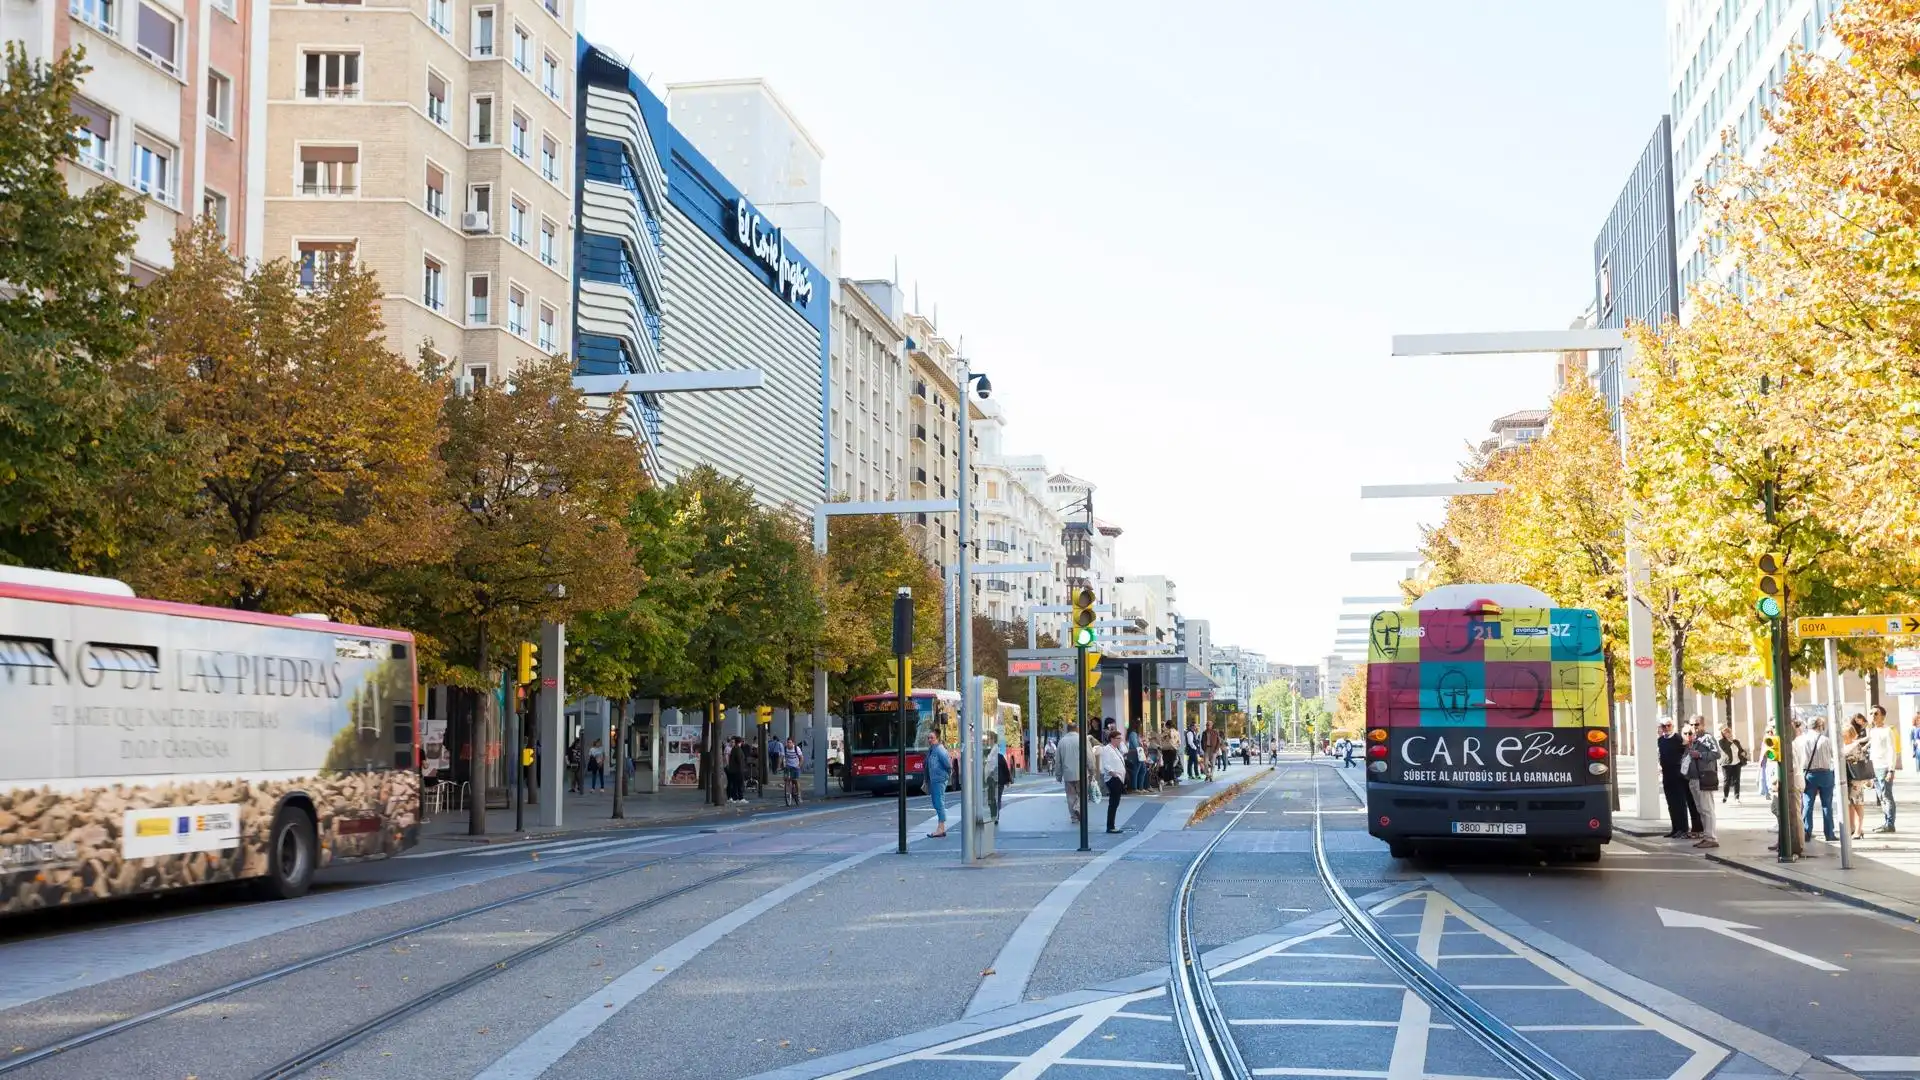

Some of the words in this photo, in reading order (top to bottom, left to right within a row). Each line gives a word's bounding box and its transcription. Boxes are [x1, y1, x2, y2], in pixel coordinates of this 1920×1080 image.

[737, 198, 751, 247] El
[752, 215, 779, 272] Corte
[1473, 625, 1494, 641] 21
[1801, 623, 1827, 633] GOYA
[109, 646, 164, 690] DE
[176, 649, 225, 695] LAS
[236, 654, 343, 700] PIEDRAS
[1519, 731, 1576, 764] Bus
[1403, 768, 1437, 782] SÚBETE
[1439, 771, 1450, 782] AL
[1452, 769, 1493, 783] AUTOBÚS
[1495, 771, 1507, 782] DE
[1509, 772, 1522, 783] LA
[1523, 772, 1573, 783] GARNACHA
[1460, 823, 1480, 833] 3800
[1485, 823, 1501, 833] JTY
